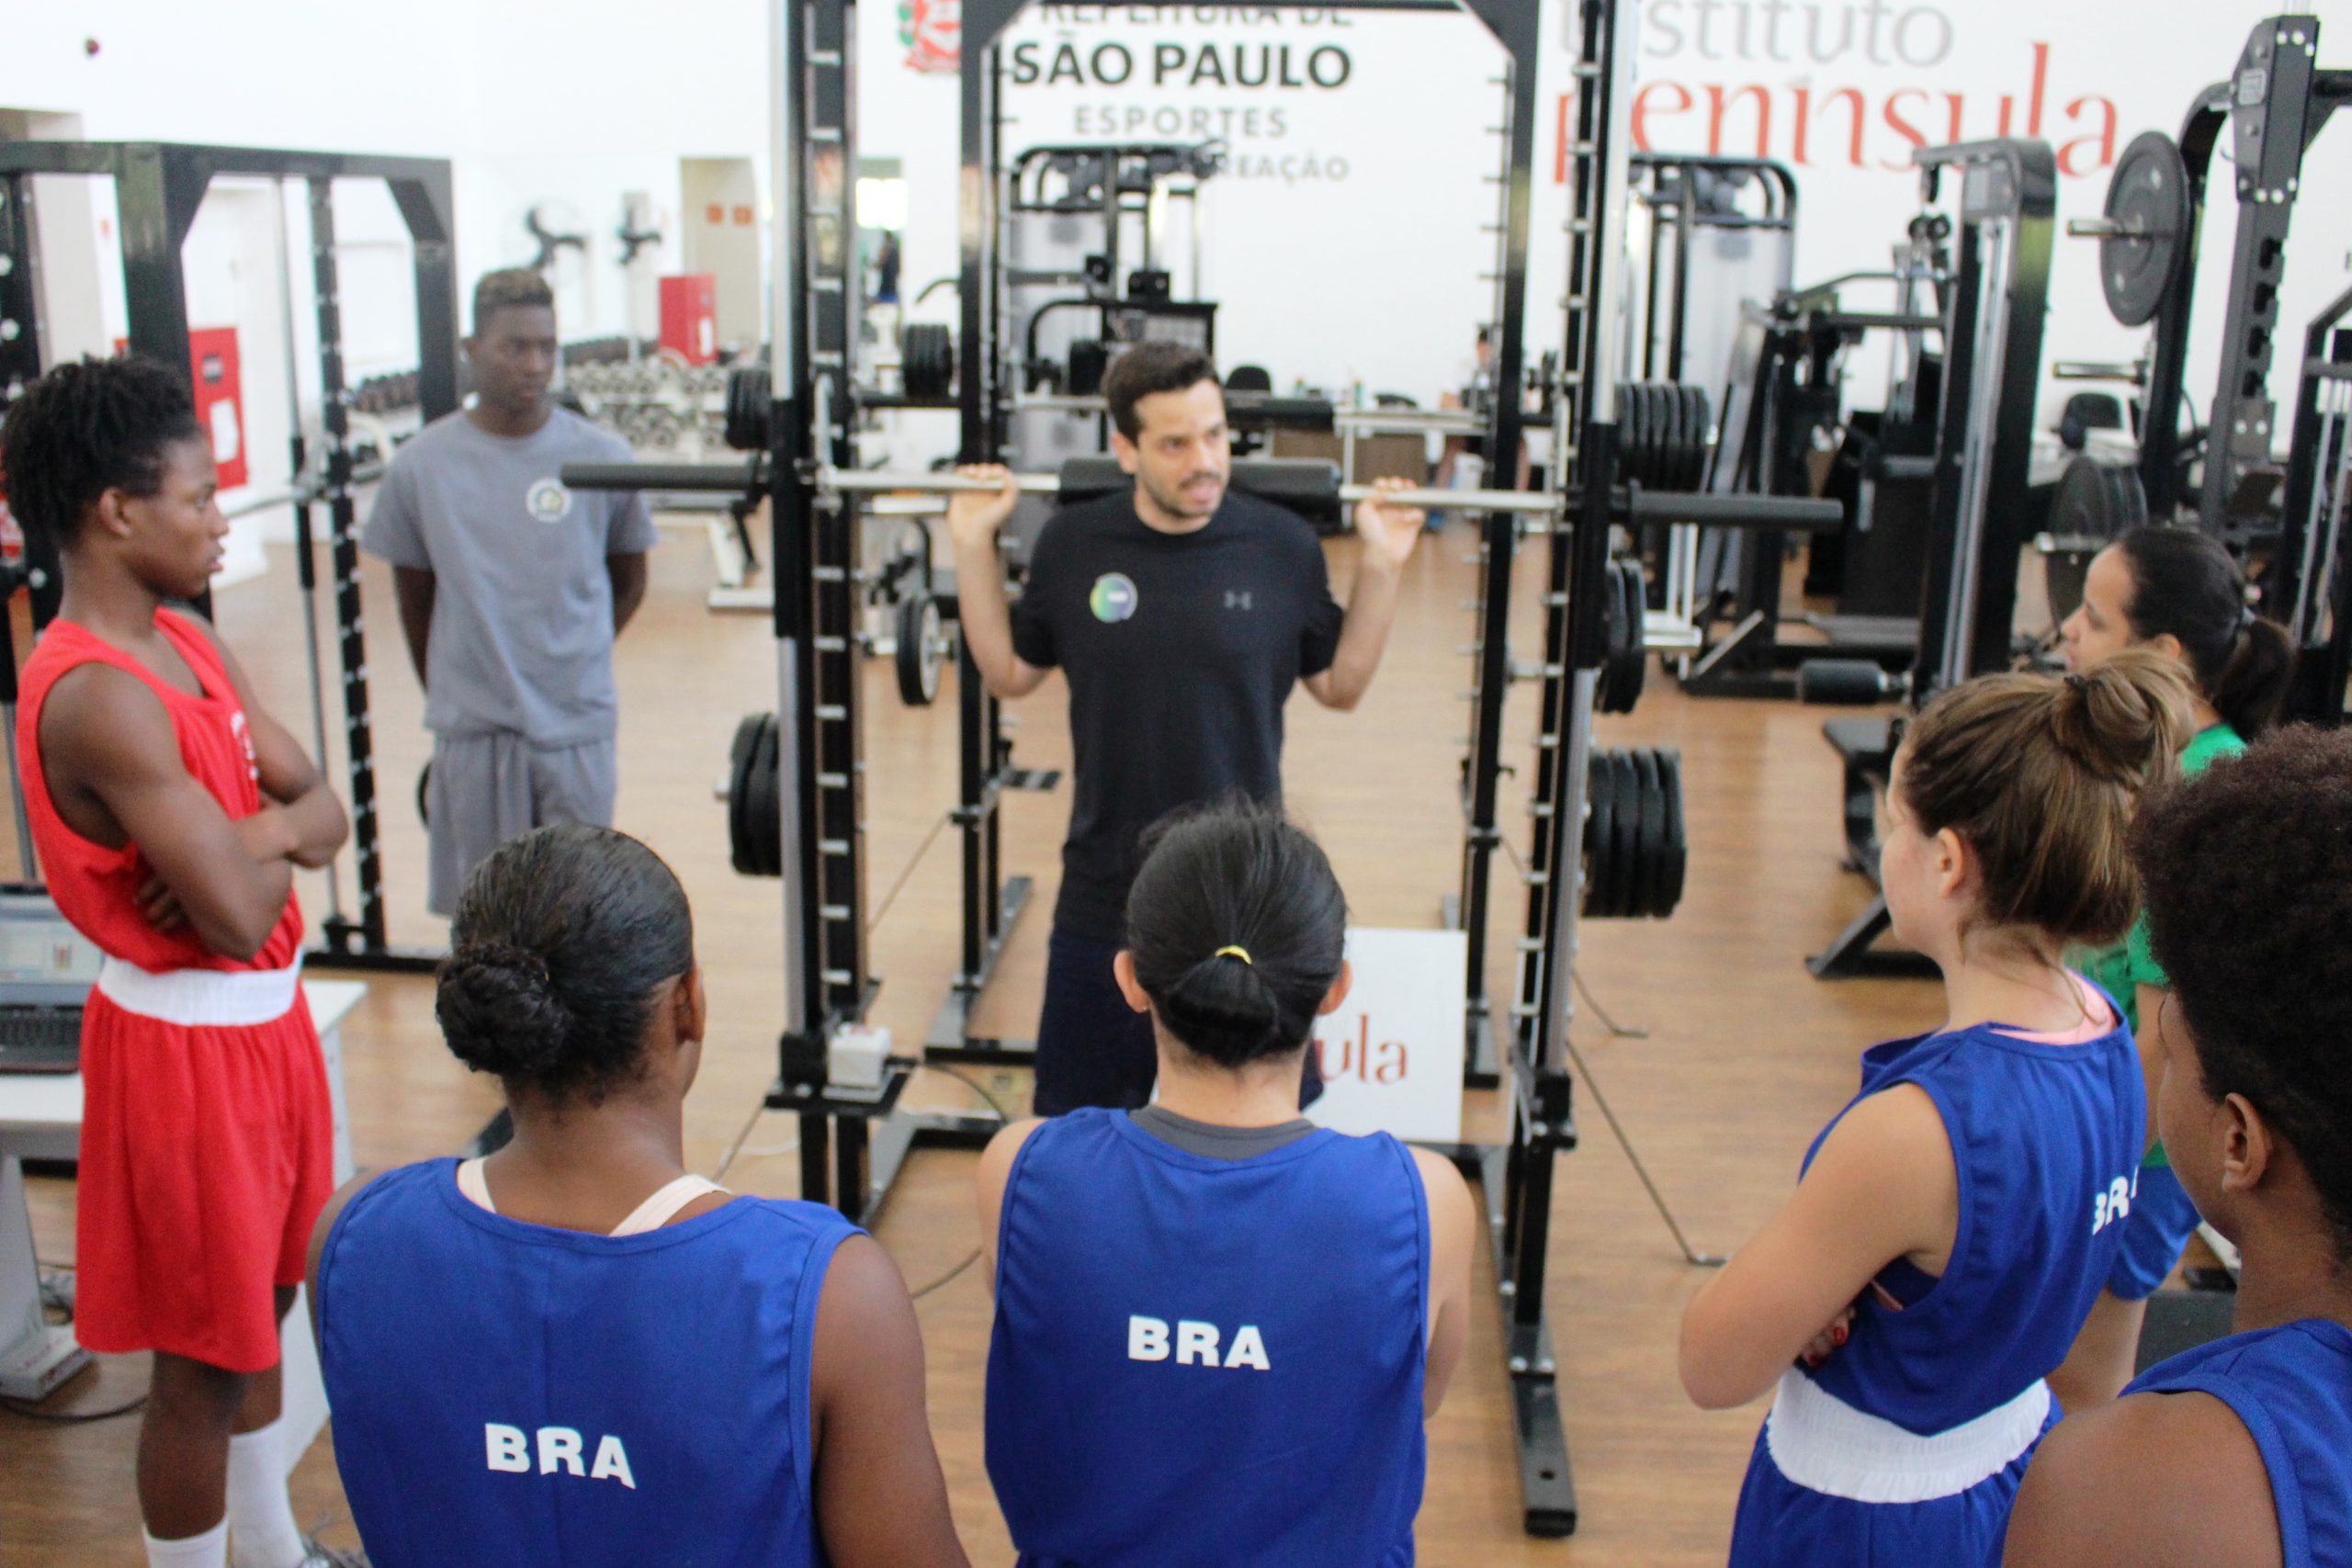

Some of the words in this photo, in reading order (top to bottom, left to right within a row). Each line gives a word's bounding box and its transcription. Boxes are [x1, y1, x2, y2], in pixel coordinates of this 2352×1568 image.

[1012, 29, 1133, 85] SÃO
[1153, 43, 1351, 88] PAULO
[1073, 104, 1289, 138] ESPORTES
[1127, 1314, 1271, 1371] BRA
[484, 1422, 636, 1490] BRA
